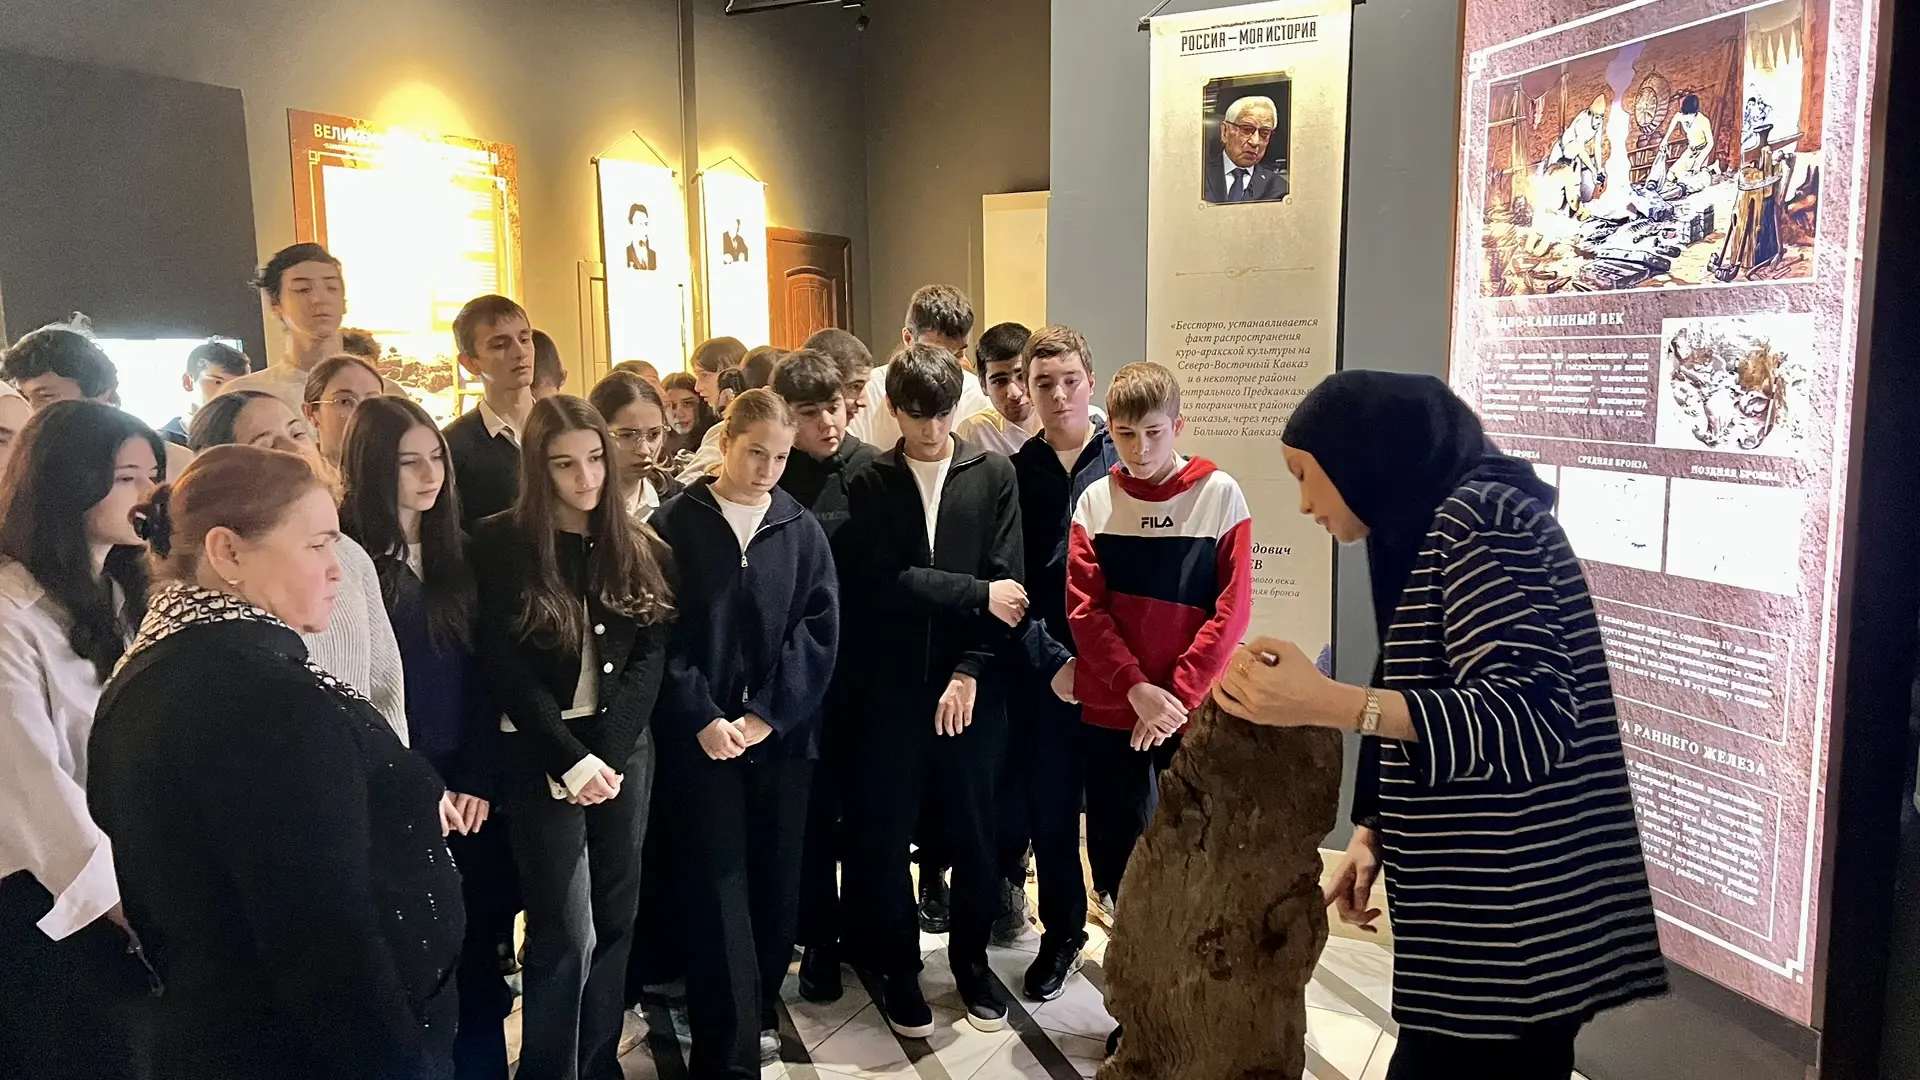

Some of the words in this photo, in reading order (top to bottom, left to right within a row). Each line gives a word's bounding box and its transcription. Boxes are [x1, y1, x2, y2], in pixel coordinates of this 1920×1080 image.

[1181, 31, 1226, 52] РОССИЯ
[1239, 27, 1263, 45] МОЯ
[1266, 21, 1317, 42] ИСТОРИЯ
[1600, 311, 1625, 325] ВЕК
[1228, 319, 1319, 331] устанавливается
[1185, 333, 1212, 345] факт
[1213, 333, 1301, 344] распространения
[1175, 346, 1244, 359] куро-аракской
[1247, 347, 1296, 358] культуры
[1298, 346, 1311, 354] на
[1177, 359, 1270, 372] Северо-Восточный
[1272, 358, 1309, 369] Кавказ
[1195, 374, 1201, 383] в
[1203, 374, 1257, 385] некоторые
[1258, 371, 1296, 385] районы
[1180, 389, 1240, 399] ентрального
[1195, 402, 1257, 412] пограничных
[1233, 415, 1258, 424] через
[1261, 415, 1289, 424] перев
[1193, 427, 1238, 437] Большого
[1241, 426, 1282, 437] Кавказа
[1577, 455, 1614, 464] СРЕДНЯЯ
[1615, 457, 1649, 469] БРОНЗА
[1691, 465, 1738, 477] ПОЗДНЯЯ
[1141, 515, 1174, 529] FILA
[1251, 542, 1291, 555] дович
[1275, 577, 1296, 585] века
[1270, 586, 1301, 599] бронза
[1632, 722, 1700, 755] РАННЕГО
[1703, 745, 1768, 777] ЖЕЛЕЗА
